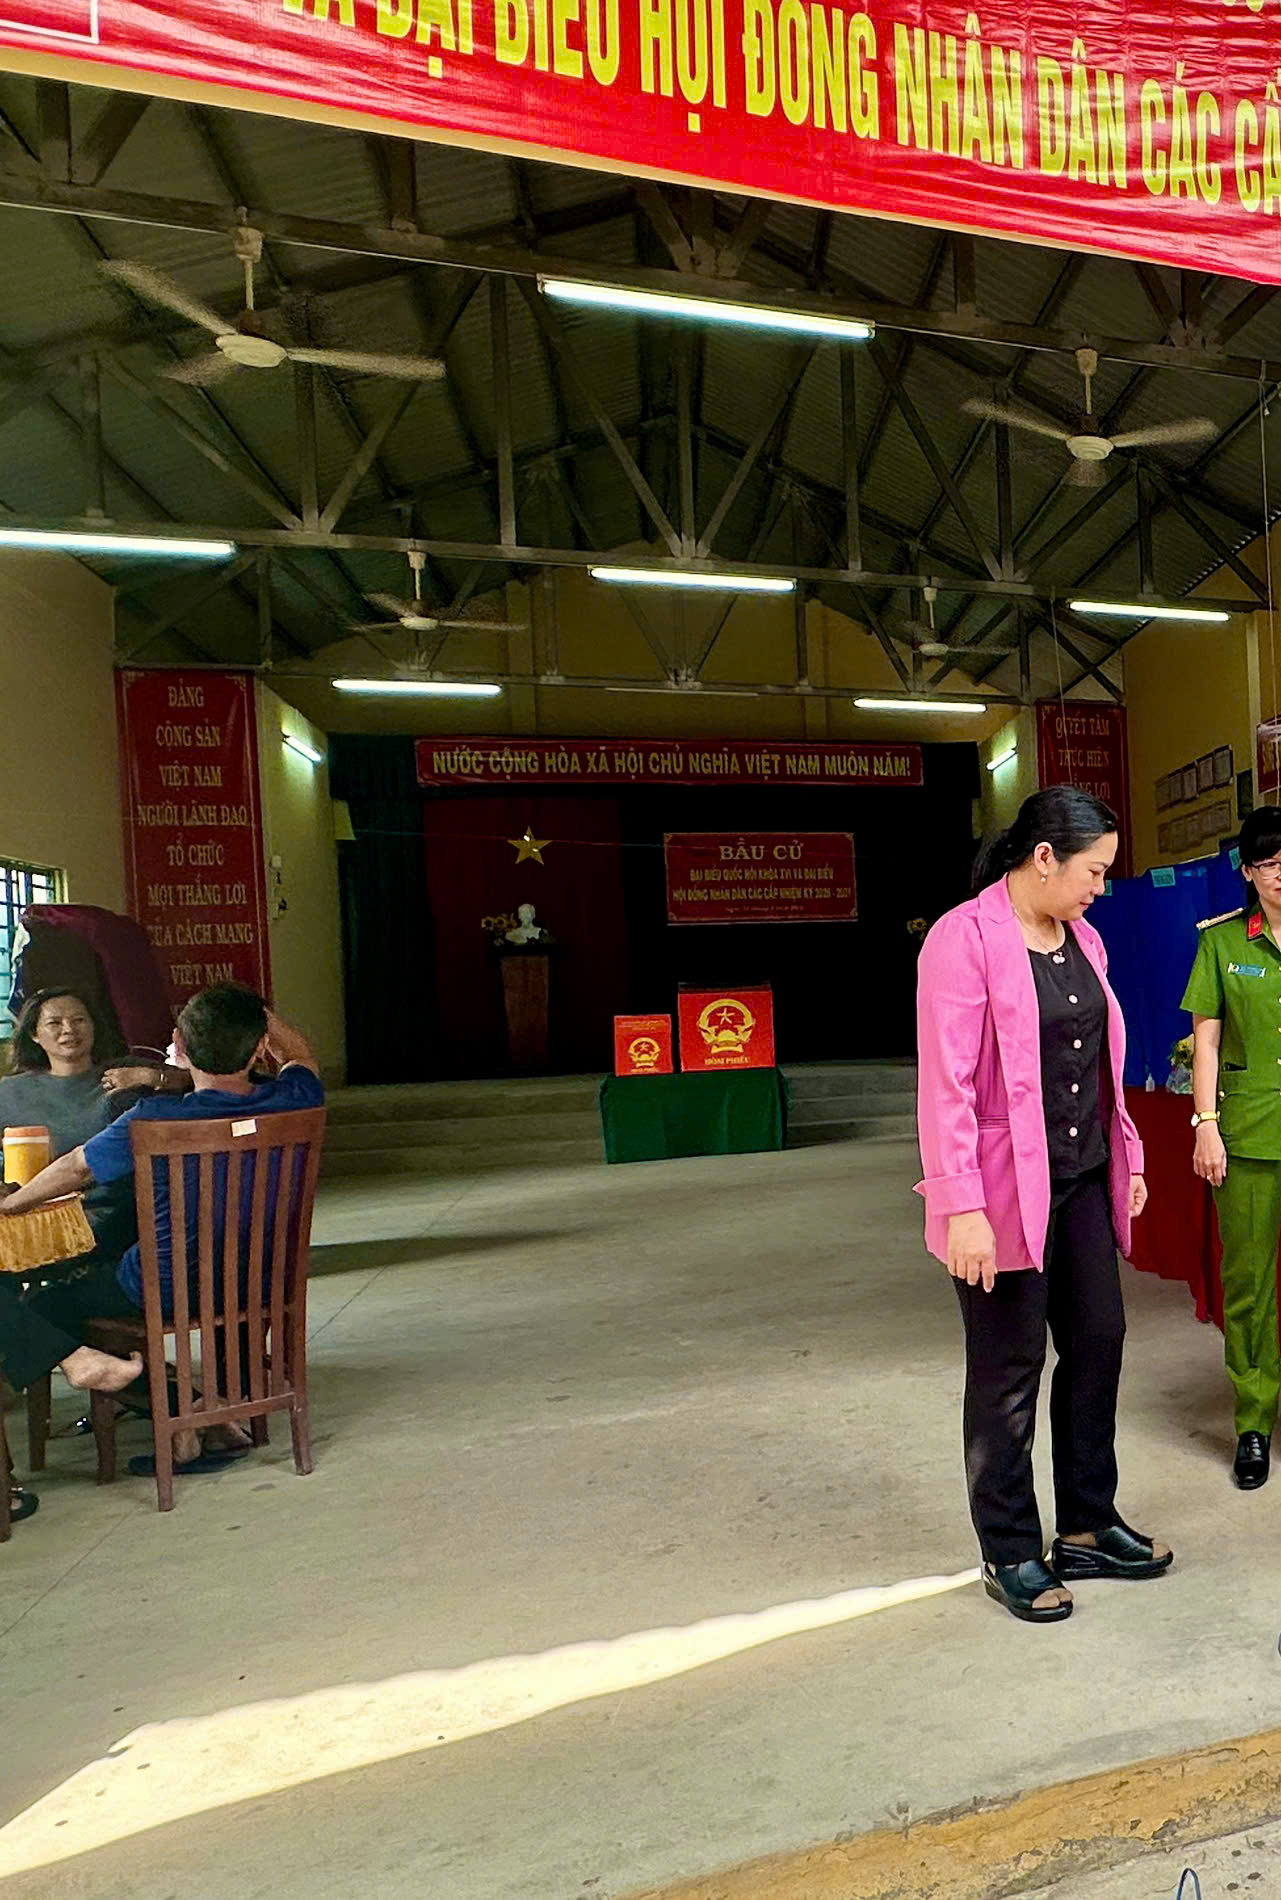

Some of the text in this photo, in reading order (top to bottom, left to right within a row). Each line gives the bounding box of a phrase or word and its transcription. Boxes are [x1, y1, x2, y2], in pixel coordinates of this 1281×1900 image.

[893, 12, 1024, 170] NHÂN
[1036, 37, 1128, 189] DÂN
[1140, 61, 1222, 206] CÁC
[167, 678, 205, 708] ĐẢNG
[155, 718, 222, 752] CỘNG SẢN
[159, 760, 223, 792] VIỆT NAM
[432, 746, 485, 774] NƯỚC
[488, 746, 540, 780] CỘNG
[544, 745, 582, 774] HÒA
[585, 745, 611, 774] XÃ
[614, 747, 645, 780] HỘI
[648, 744, 683, 774] CHỦ
[688, 747, 741, 775] NGHĨA
[744, 749, 782, 780] VIỆT
[785, 753, 821, 776] NAM
[823, 750, 869, 777] MUÔN
[137, 800, 248, 831] NGƯỜI LÃNH ĐẠO
[188, 838, 225, 866] CHỨC
[719, 837, 804, 860] BẦU CỬ
[205, 962, 233, 984] NAM
